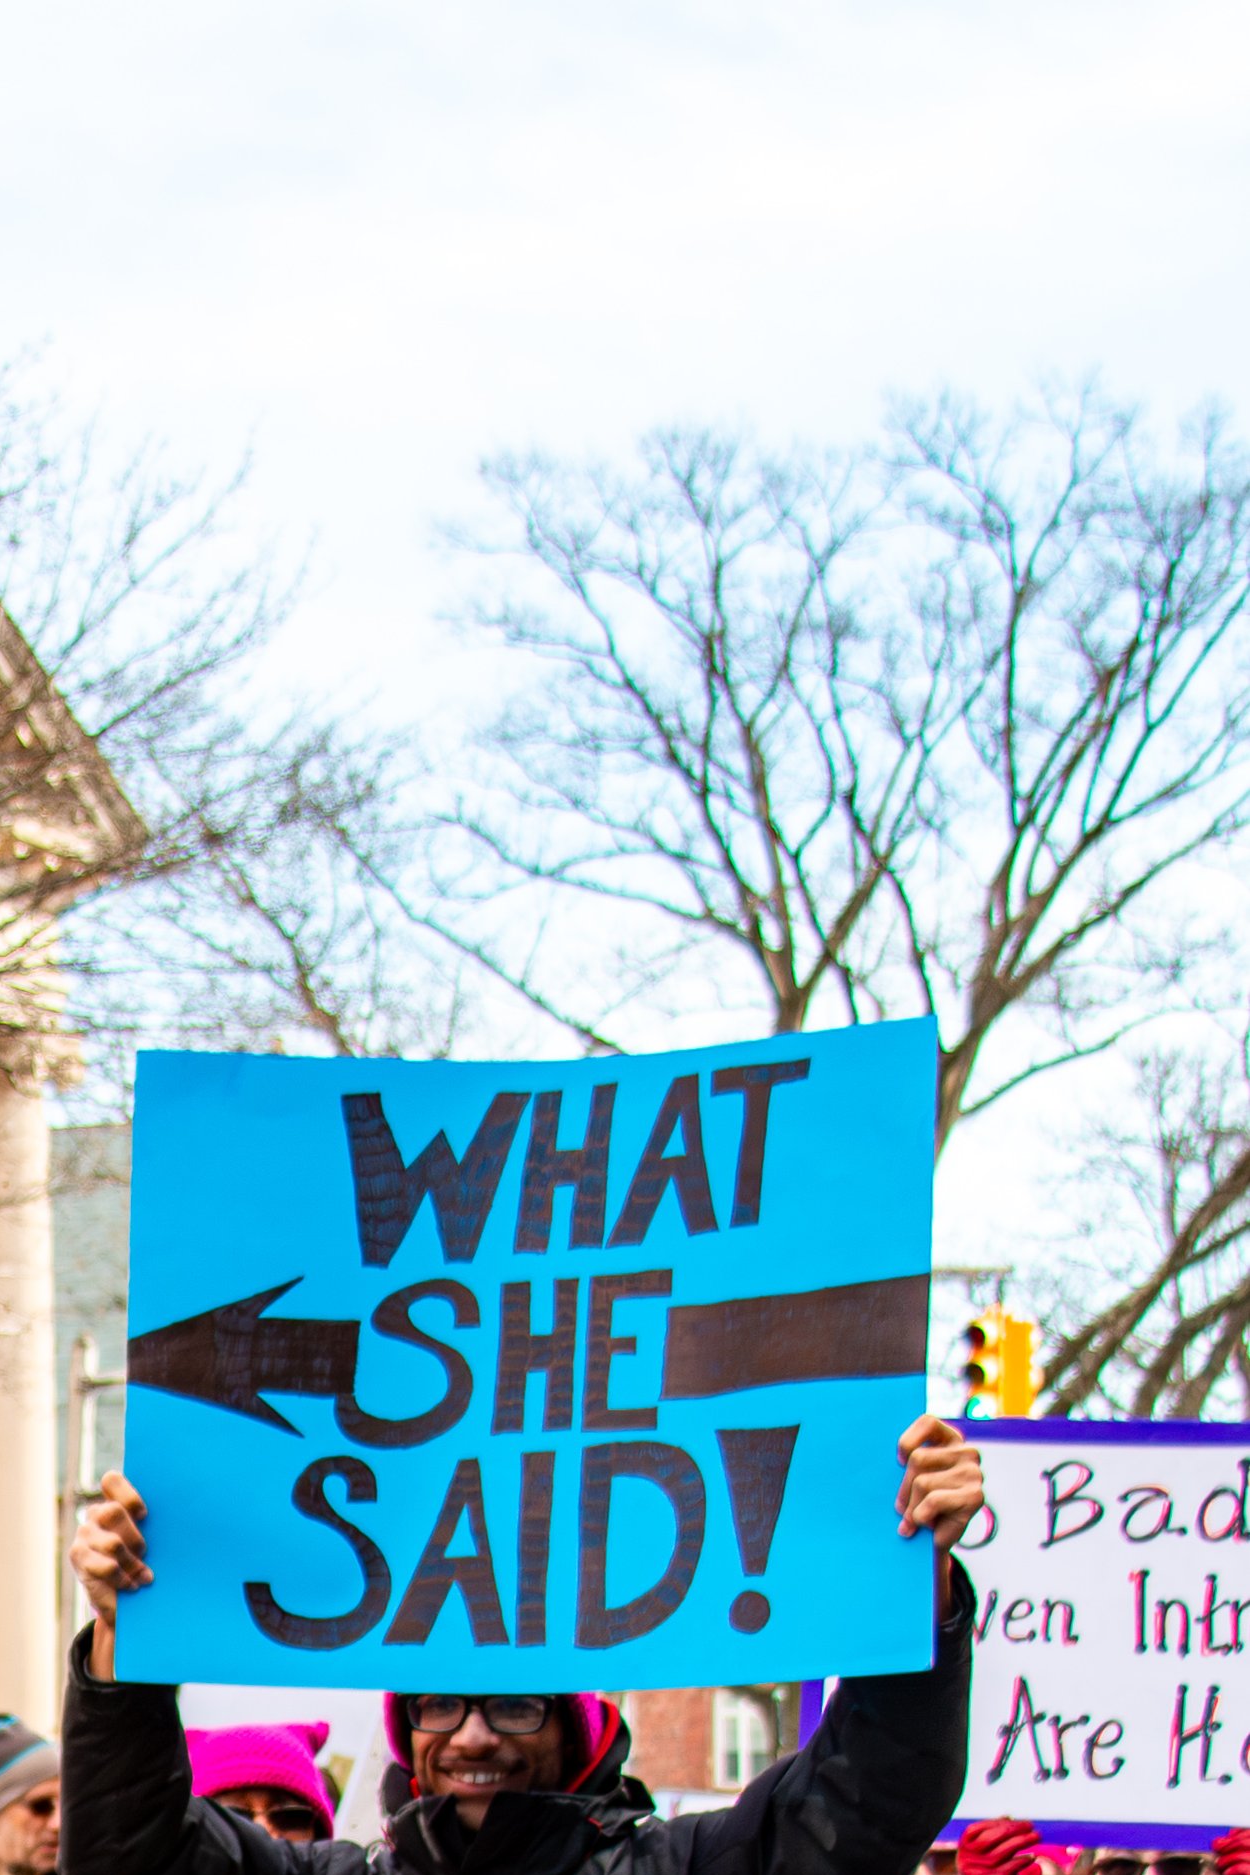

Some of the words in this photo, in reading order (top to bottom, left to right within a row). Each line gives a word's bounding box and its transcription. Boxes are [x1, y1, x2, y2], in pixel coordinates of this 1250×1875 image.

[338, 1058, 811, 1268] WHAT
[335, 1268, 673, 1449] SHE
[243, 1424, 800, 1651] SAID!
[1039, 1457, 1250, 1549] Bad
[972, 1588, 1080, 1647] ven
[986, 1676, 1126, 1786] Are
